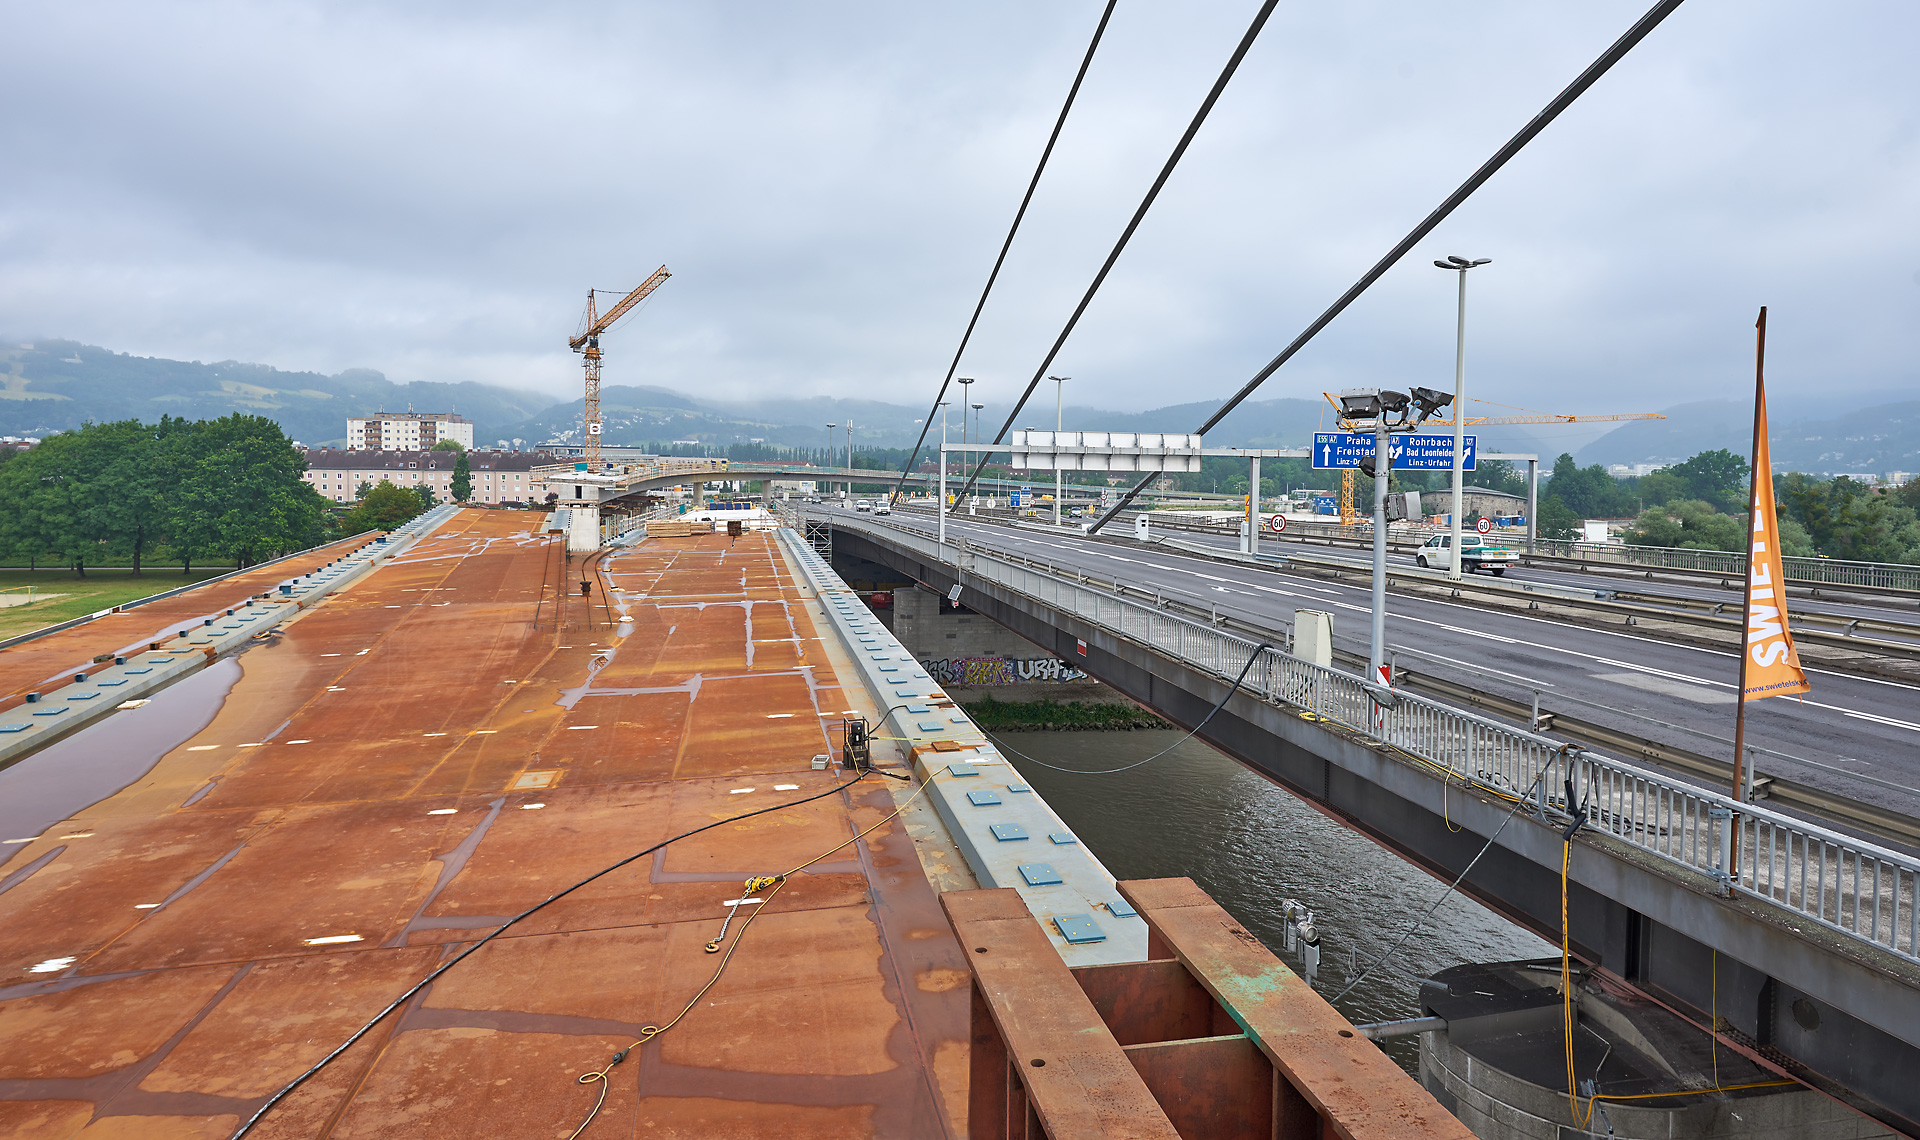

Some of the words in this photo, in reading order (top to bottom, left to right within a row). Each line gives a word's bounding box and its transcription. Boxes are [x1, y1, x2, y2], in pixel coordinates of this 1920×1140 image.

[1346, 436, 1371, 445] Praha
[1409, 437, 1452, 447] Rohrbach
[1337, 447, 1376, 456] Freistad
[1406, 448, 1419, 457] Bad
[1408, 459, 1452, 467] Linz-Urfahr
[1274, 518, 1284, 528] 60
[1479, 521, 1488, 530] 60
